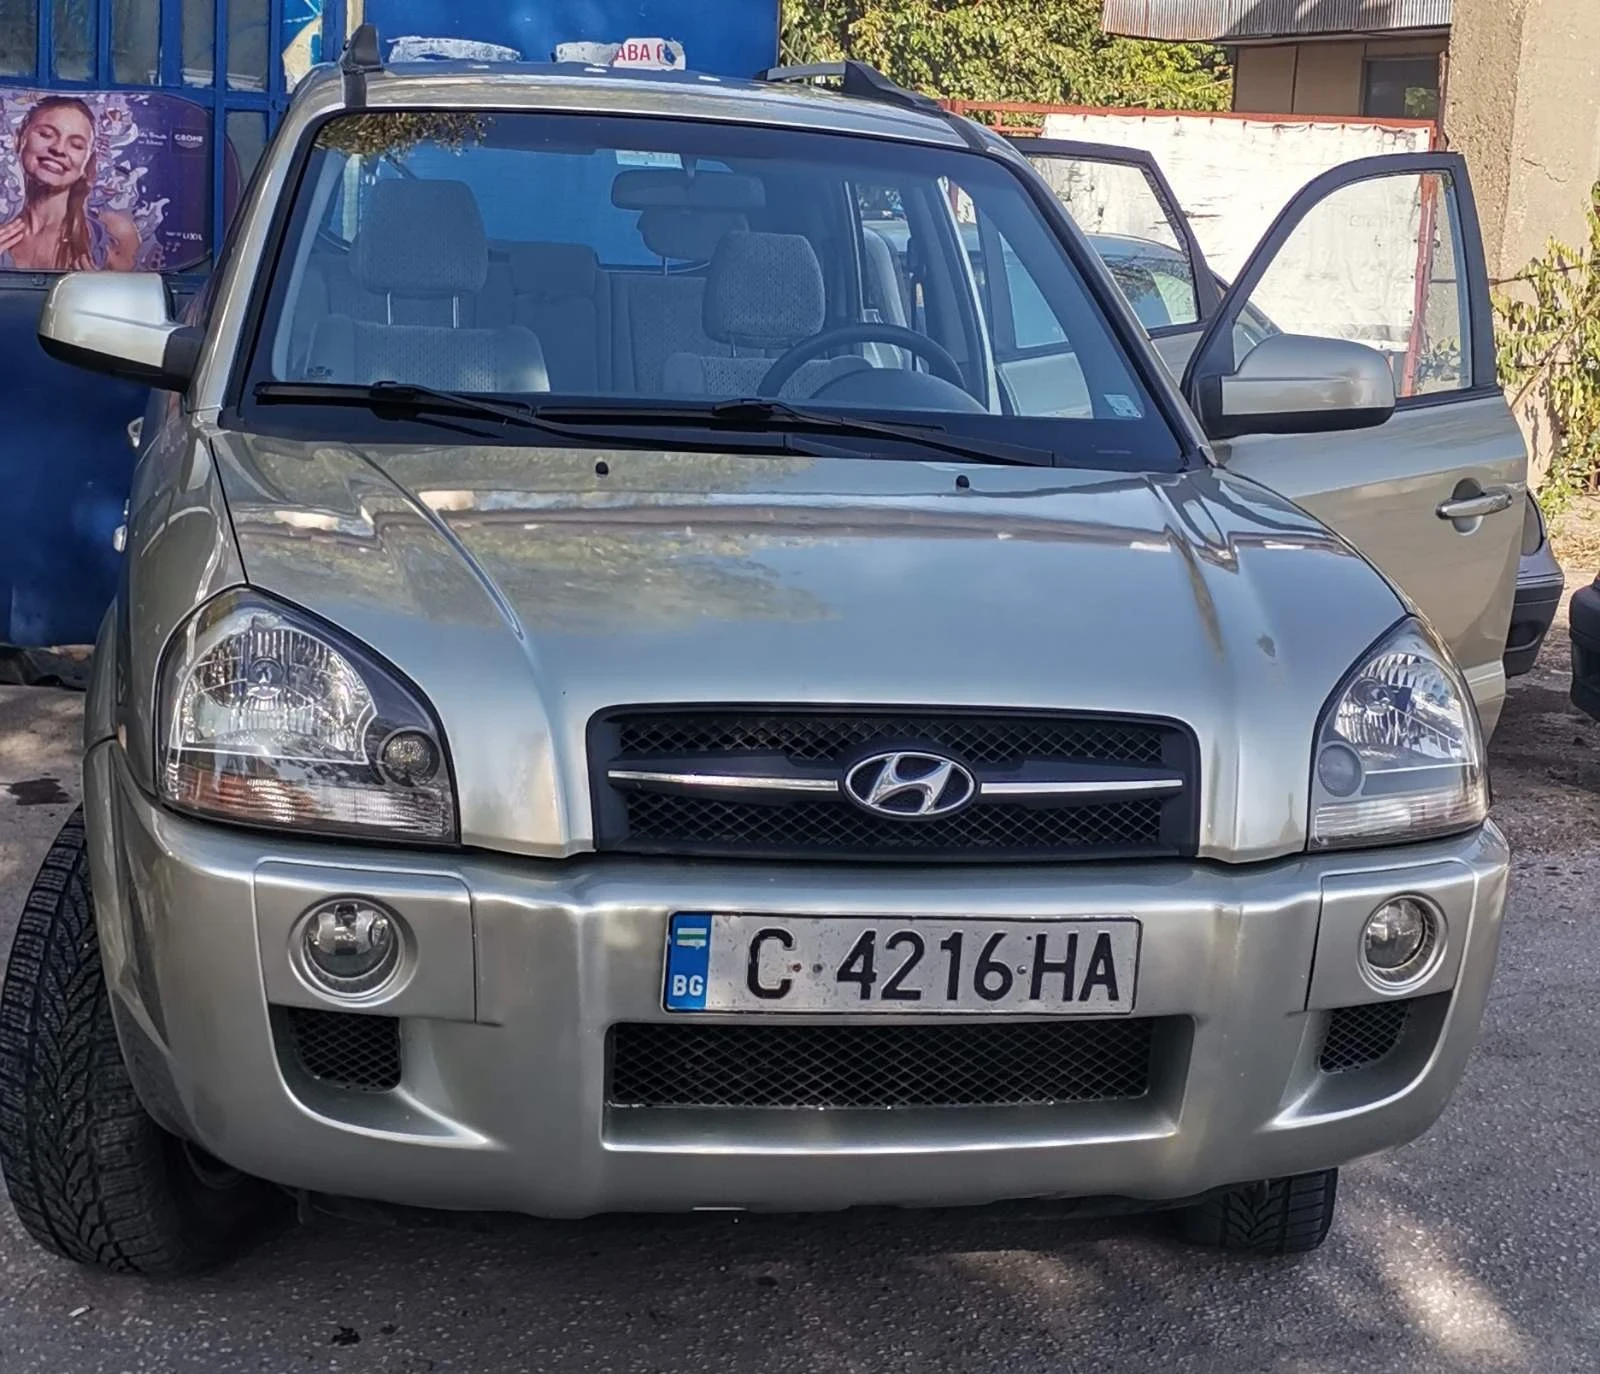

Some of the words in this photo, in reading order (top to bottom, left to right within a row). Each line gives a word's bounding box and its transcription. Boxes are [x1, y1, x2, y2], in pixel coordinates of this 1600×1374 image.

[672, 975, 704, 997] BG
[746, 927, 795, 1000] C
[835, 928, 1014, 1001] 4216
[1028, 931, 1120, 1002] HA
